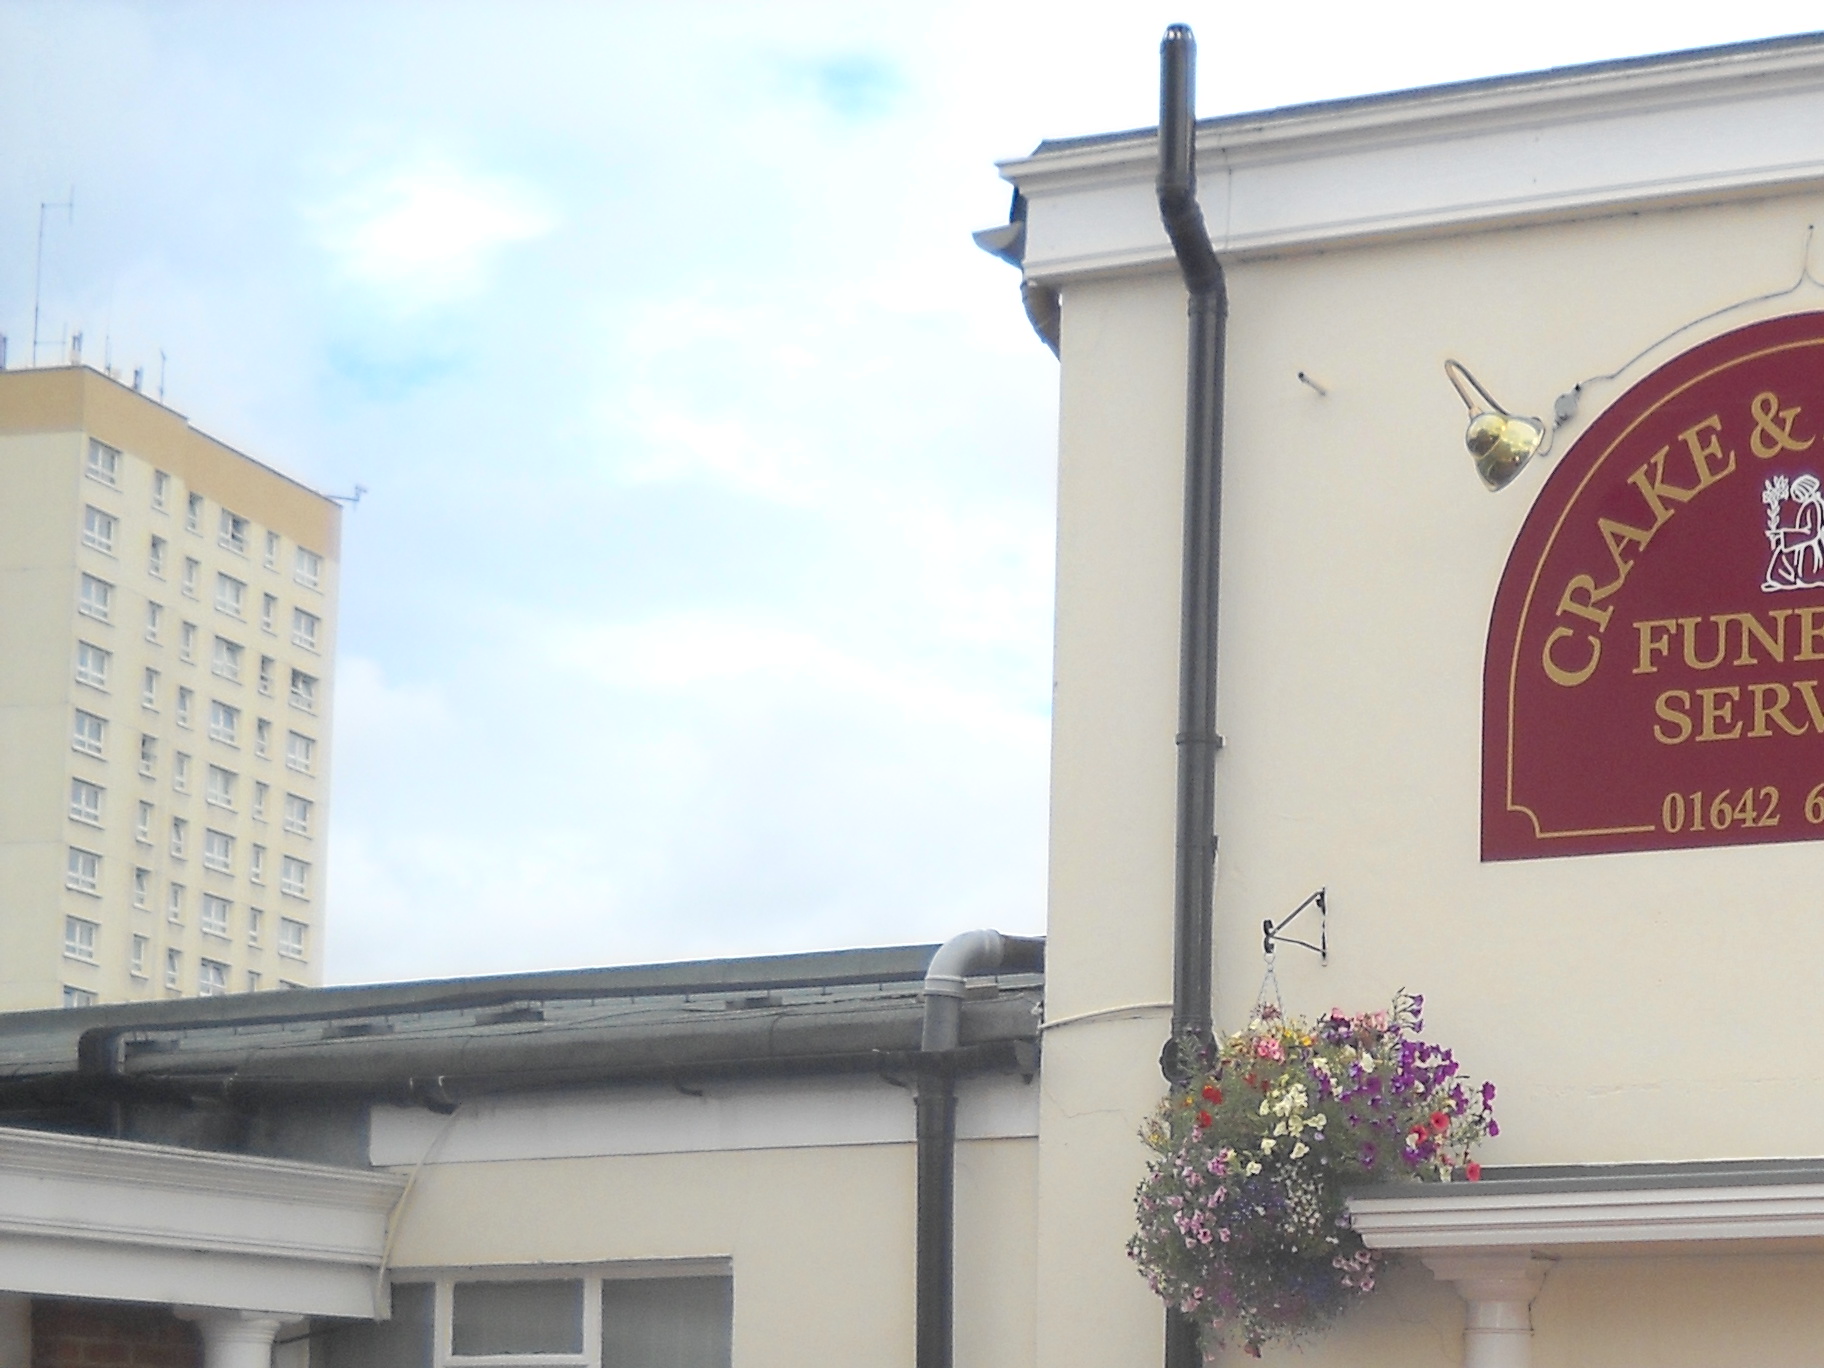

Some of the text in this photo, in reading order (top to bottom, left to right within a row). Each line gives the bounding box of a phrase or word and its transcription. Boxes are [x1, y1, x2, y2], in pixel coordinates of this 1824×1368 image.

[1542, 414, 1737, 688] CRAKE
[1750, 391, 1814, 459] &
[1661, 786, 1781, 833] 01642
